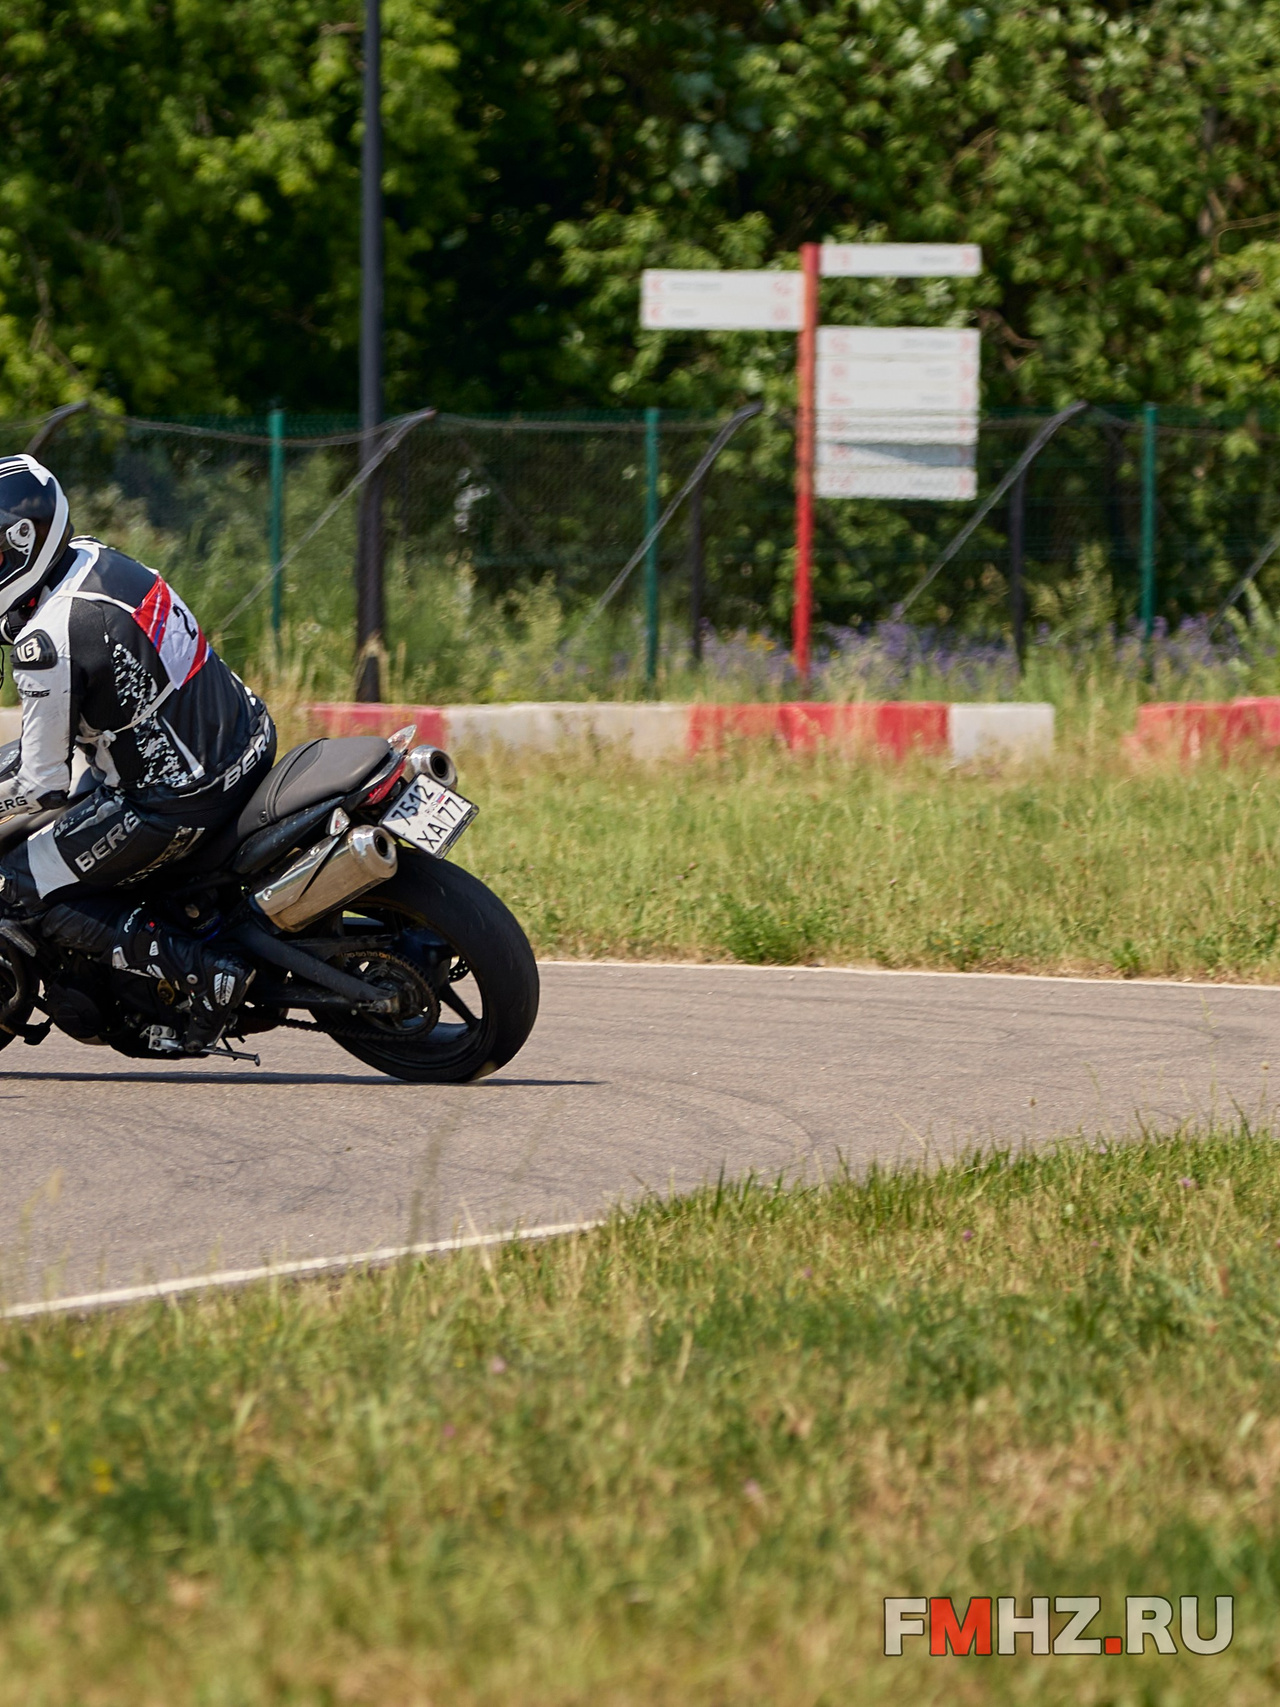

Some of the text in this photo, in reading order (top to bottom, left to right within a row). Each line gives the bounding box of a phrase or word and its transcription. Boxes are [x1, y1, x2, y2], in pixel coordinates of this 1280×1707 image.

[172, 603, 198, 641] 2
[391, 784, 435, 827] 7512
[437, 796, 464, 822] 77
[74, 809, 142, 873] BERG
